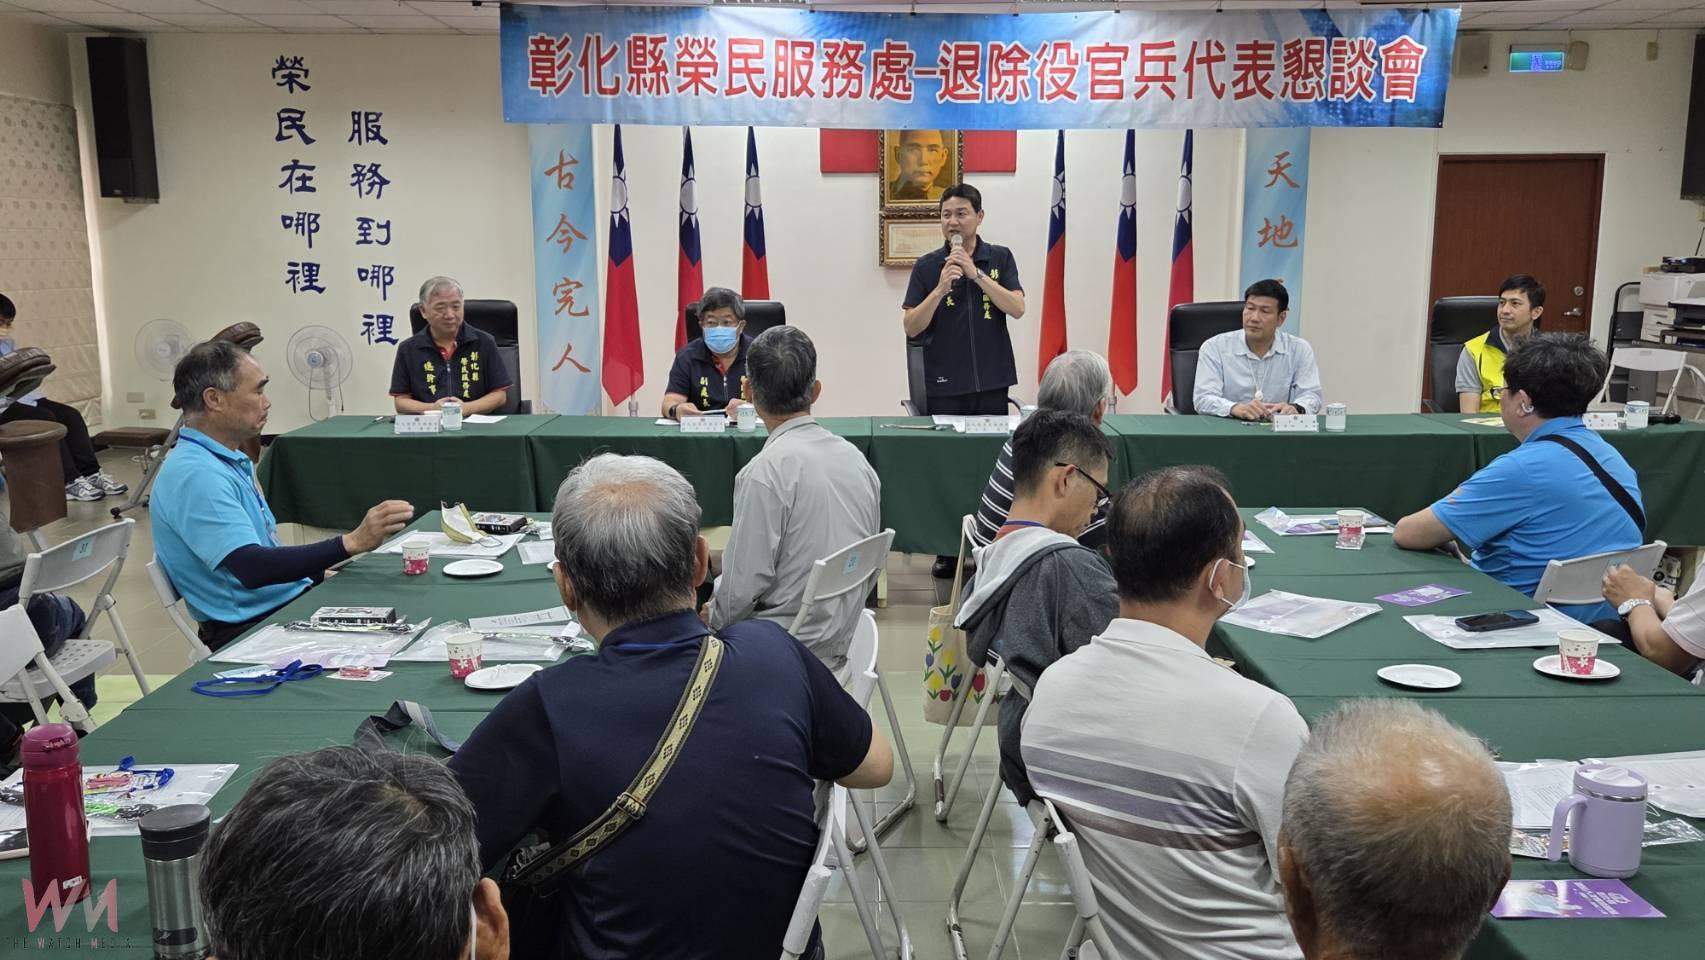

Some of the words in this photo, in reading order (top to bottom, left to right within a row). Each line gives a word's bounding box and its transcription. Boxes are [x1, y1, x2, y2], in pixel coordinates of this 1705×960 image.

[271, 55, 327, 294] 榮民在哪裡
[348, 110, 400, 345] 服務到哪裡
[544, 148, 591, 373] 古今完人
[1257, 151, 1300, 283] 天地
